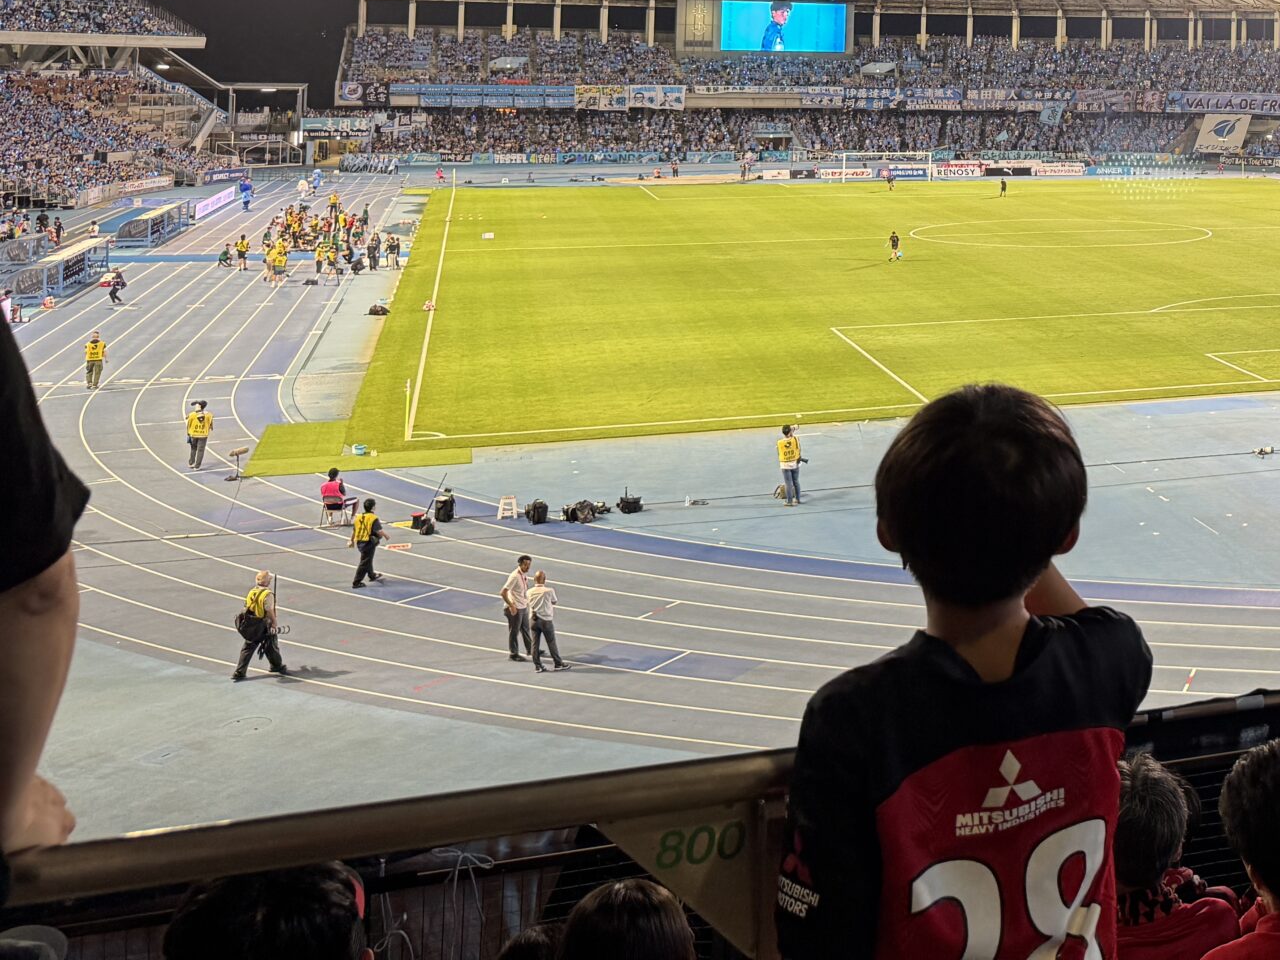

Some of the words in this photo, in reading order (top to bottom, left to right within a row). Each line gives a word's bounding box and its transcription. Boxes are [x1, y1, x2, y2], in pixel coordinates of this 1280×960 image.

[1186, 97, 1211, 110] VAI
[1215, 95, 1235, 110] LÁ
[1241, 98, 1258, 111] DE
[937, 168, 976, 176] RENOSY
[1096, 167, 1123, 175] ANKER
[955, 787, 1065, 827] MITSUBISHI
[955, 823, 996, 837] HEAVY
[997, 798, 1066, 831] INDUSTRIES
[655, 820, 748, 871] 800
[778, 874, 820, 907] TSUBISHI
[778, 890, 809, 918] OTORS
